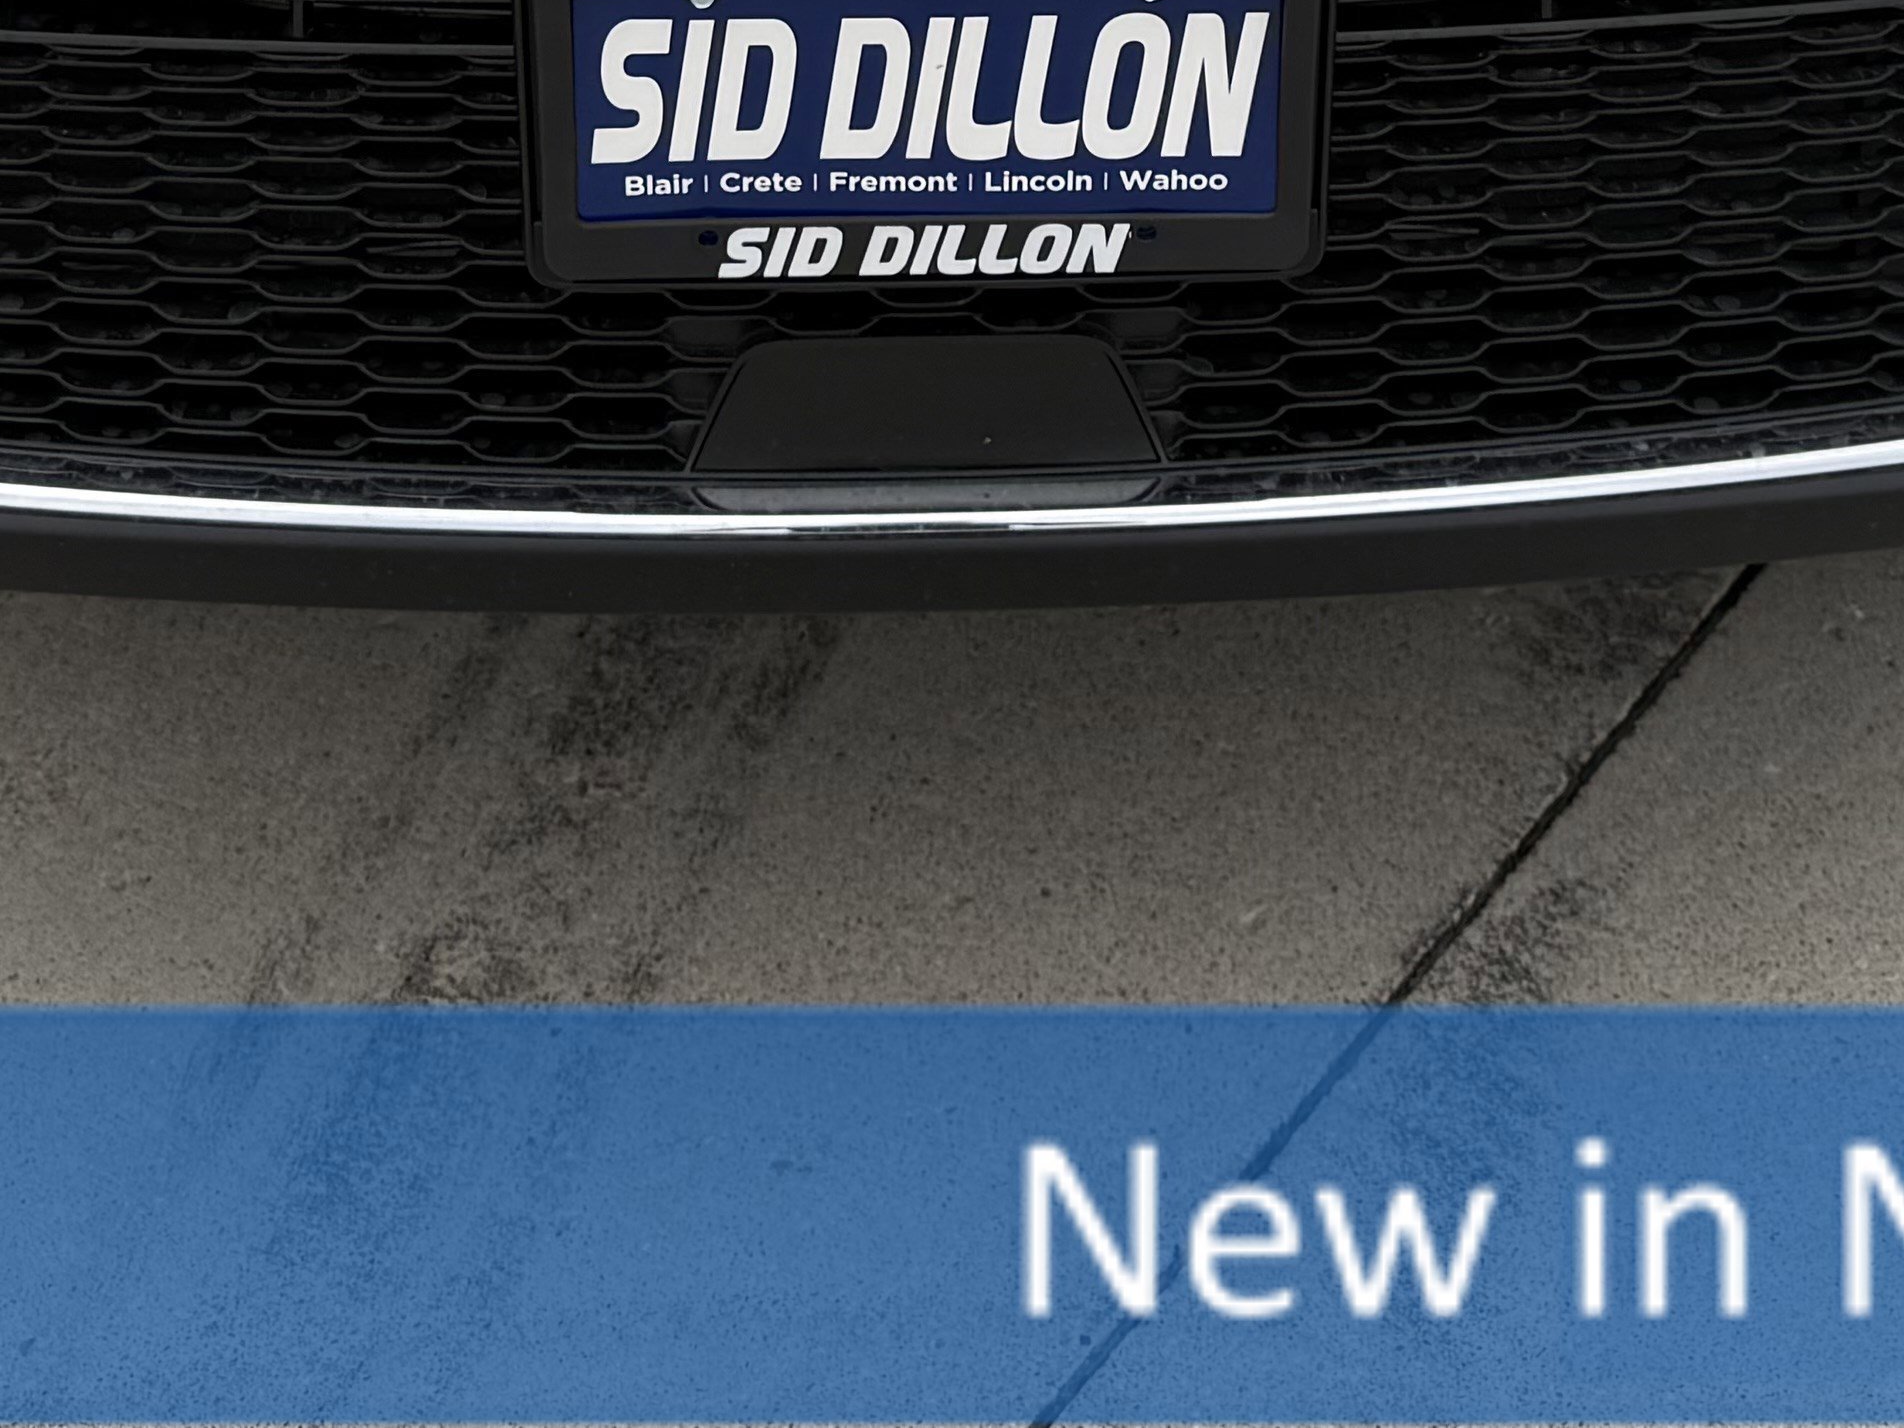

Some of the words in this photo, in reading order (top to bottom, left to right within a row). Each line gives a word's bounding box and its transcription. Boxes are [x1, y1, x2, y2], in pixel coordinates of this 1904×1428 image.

[591, 18, 797, 164] SID
[819, 12, 1270, 162] DILLON
[624, 173, 694, 197] Blair
[719, 171, 803, 194] Crete
[829, 170, 958, 193] Fremont
[984, 169, 1093, 193] Lincoln
[1119, 169, 1228, 192] Wahoo
[717, 225, 844, 279] SID
[858, 223, 1130, 276] DILLON
